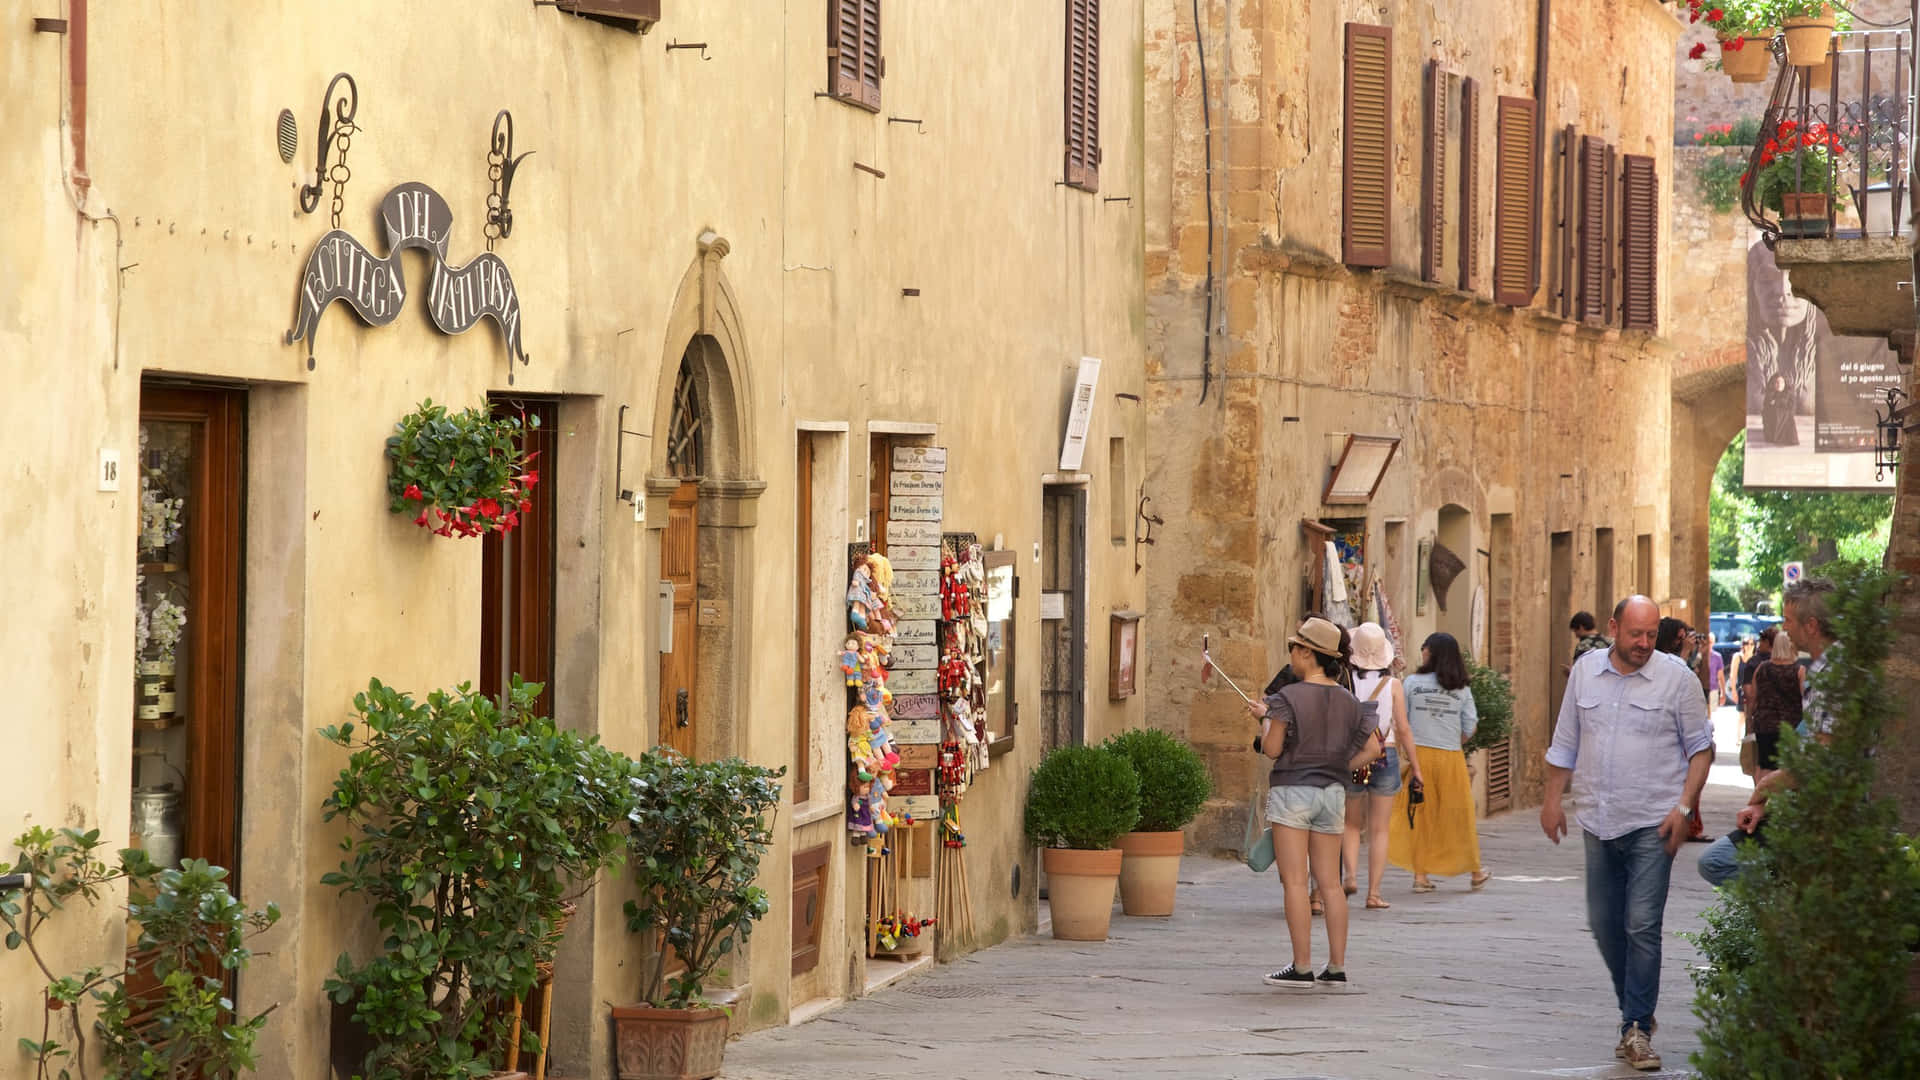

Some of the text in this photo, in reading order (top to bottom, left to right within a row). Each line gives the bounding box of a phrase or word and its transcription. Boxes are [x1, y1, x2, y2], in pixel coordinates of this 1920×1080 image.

[304, 190, 519, 345] BOTTEGA DEL NATURISTA
[1840, 362, 1852, 371] dal
[1859, 362, 1885, 372] giugno
[1848, 376, 1858, 384] 30
[1859, 375, 1883, 384] agosto
[1884, 375, 1901, 384] 2015
[104, 460, 117, 481] 18
